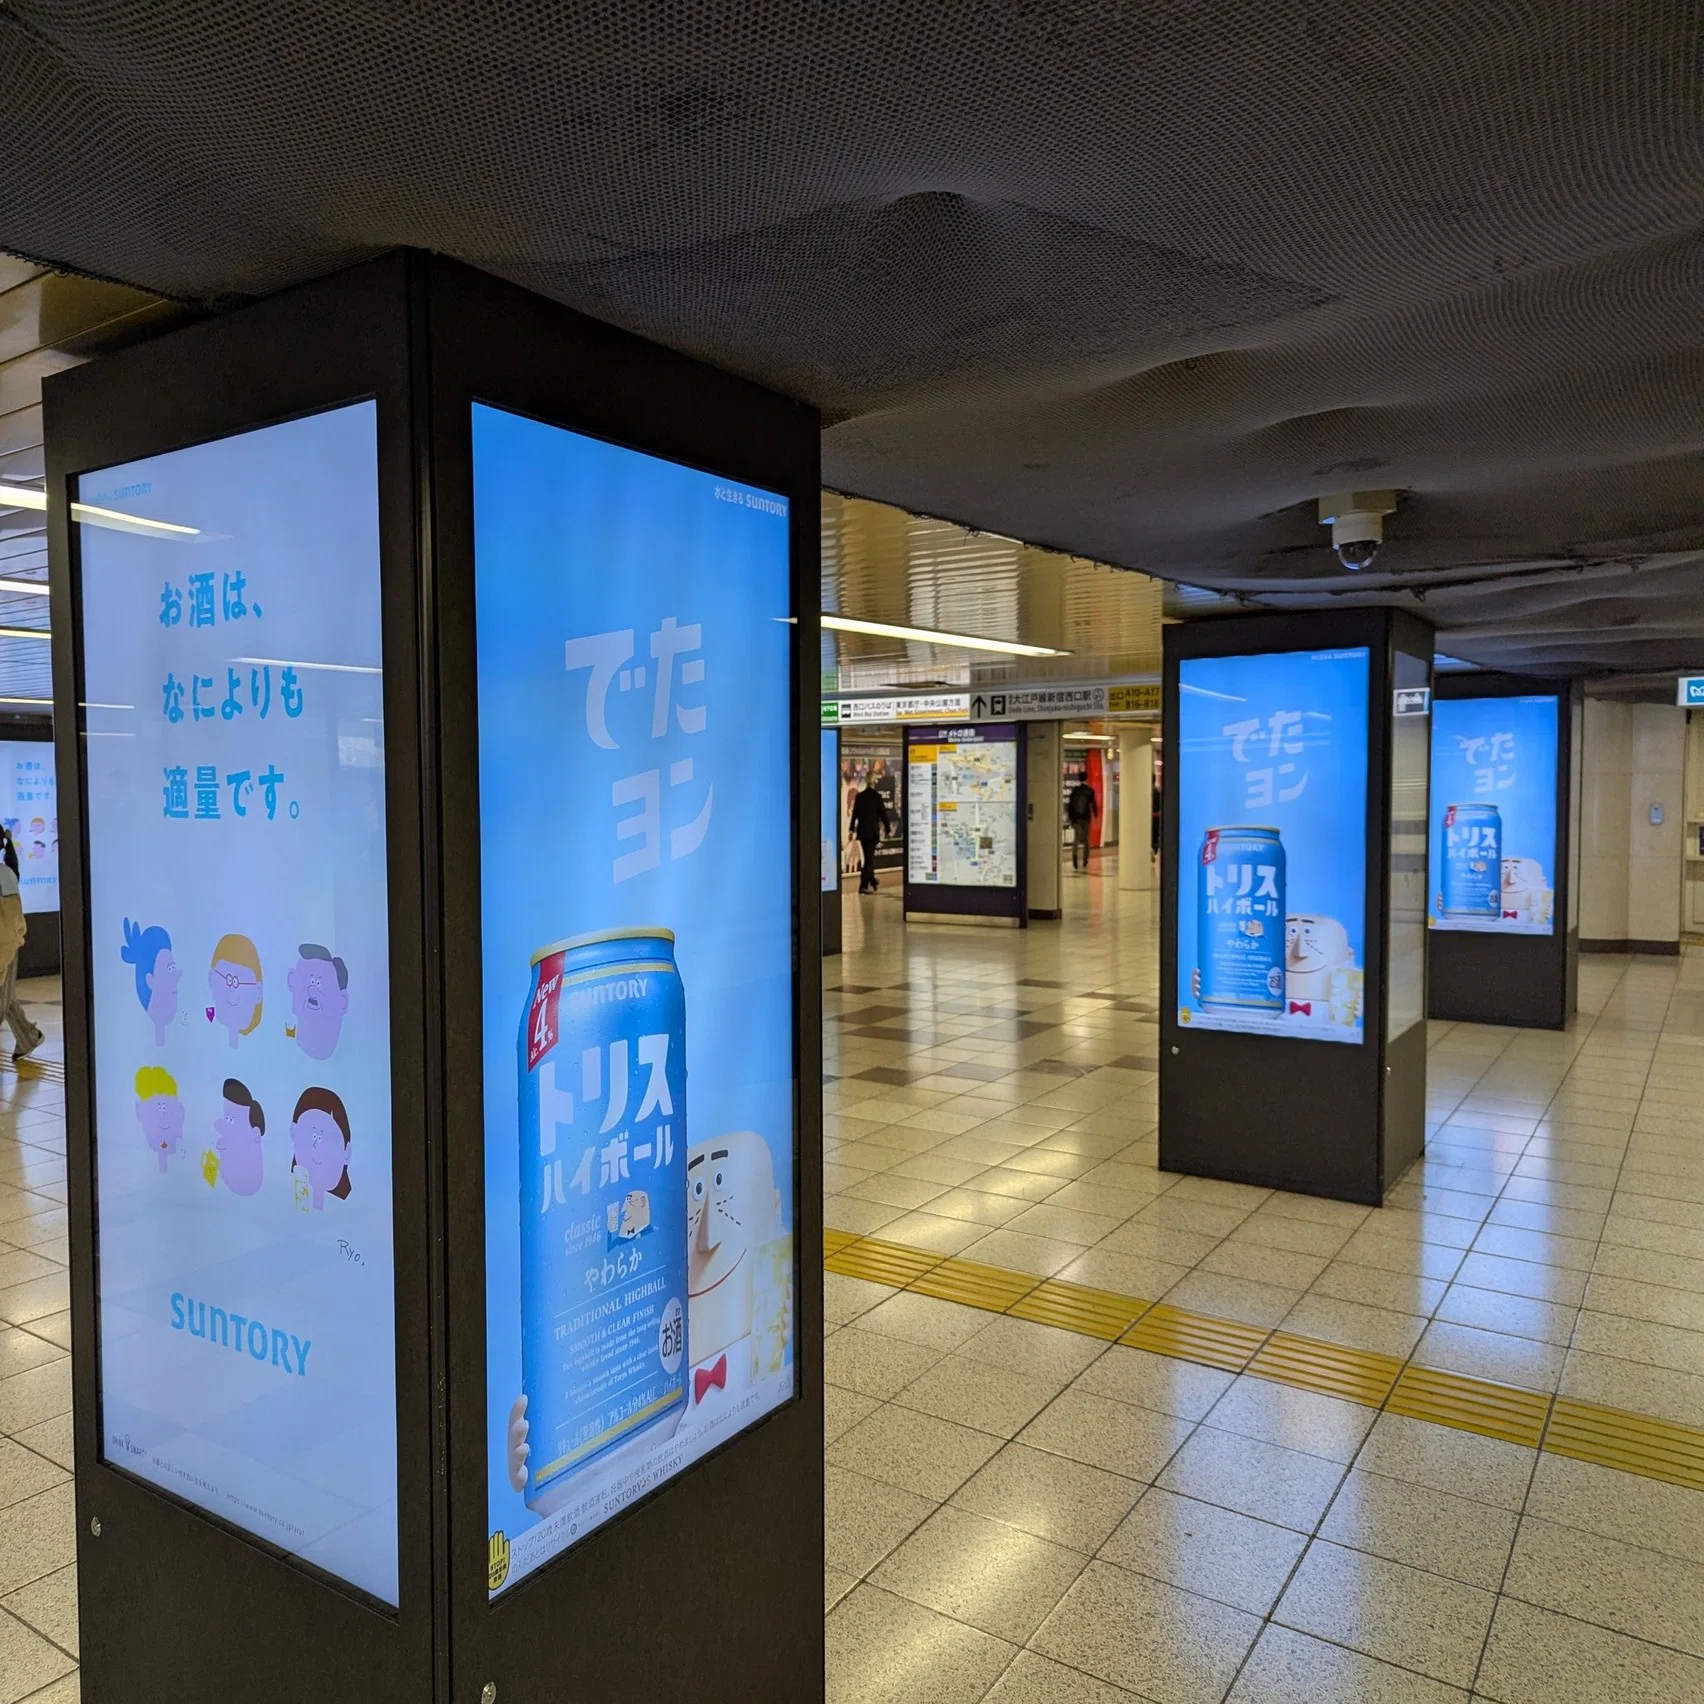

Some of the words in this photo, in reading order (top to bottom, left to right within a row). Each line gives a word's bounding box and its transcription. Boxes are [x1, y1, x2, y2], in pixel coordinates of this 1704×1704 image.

[746, 494, 788, 517] SUNTORY
[159, 570, 263, 628] お酒は、
[162, 663, 304, 724] なによりも
[565, 616, 707, 750] でた
[1222, 710, 1304, 763] でた
[1459, 732, 1515, 765] でた
[163, 764, 300, 821] 適量です。
[1244, 762, 1308, 809] ヨン
[1474, 765, 1516, 793] ヨン
[612, 757, 713, 885] ヨン
[1447, 826, 1497, 848] トリス
[1206, 864, 1278, 898] トリス
[1206, 897, 1279, 917] ハイボール
[532, 974, 560, 1010] New
[571, 978, 648, 1008] UNTORY
[539, 1033, 674, 1157] トリス
[540, 1124, 674, 1214] ハイボール
[564, 1214, 601, 1243] classic
[584, 1247, 643, 1293] やわらか
[554, 1297, 622, 1341] TRADITIONAL
[624, 1277, 667, 1305] HIGHBALL
[570, 1332, 600, 1354] SMOOTH
[607, 1316, 631, 1334] CLEAR
[633, 1304, 655, 1322] FINISH
[170, 1292, 311, 1377] SUNTORY
[652, 1453, 683, 1481] WHISKY
